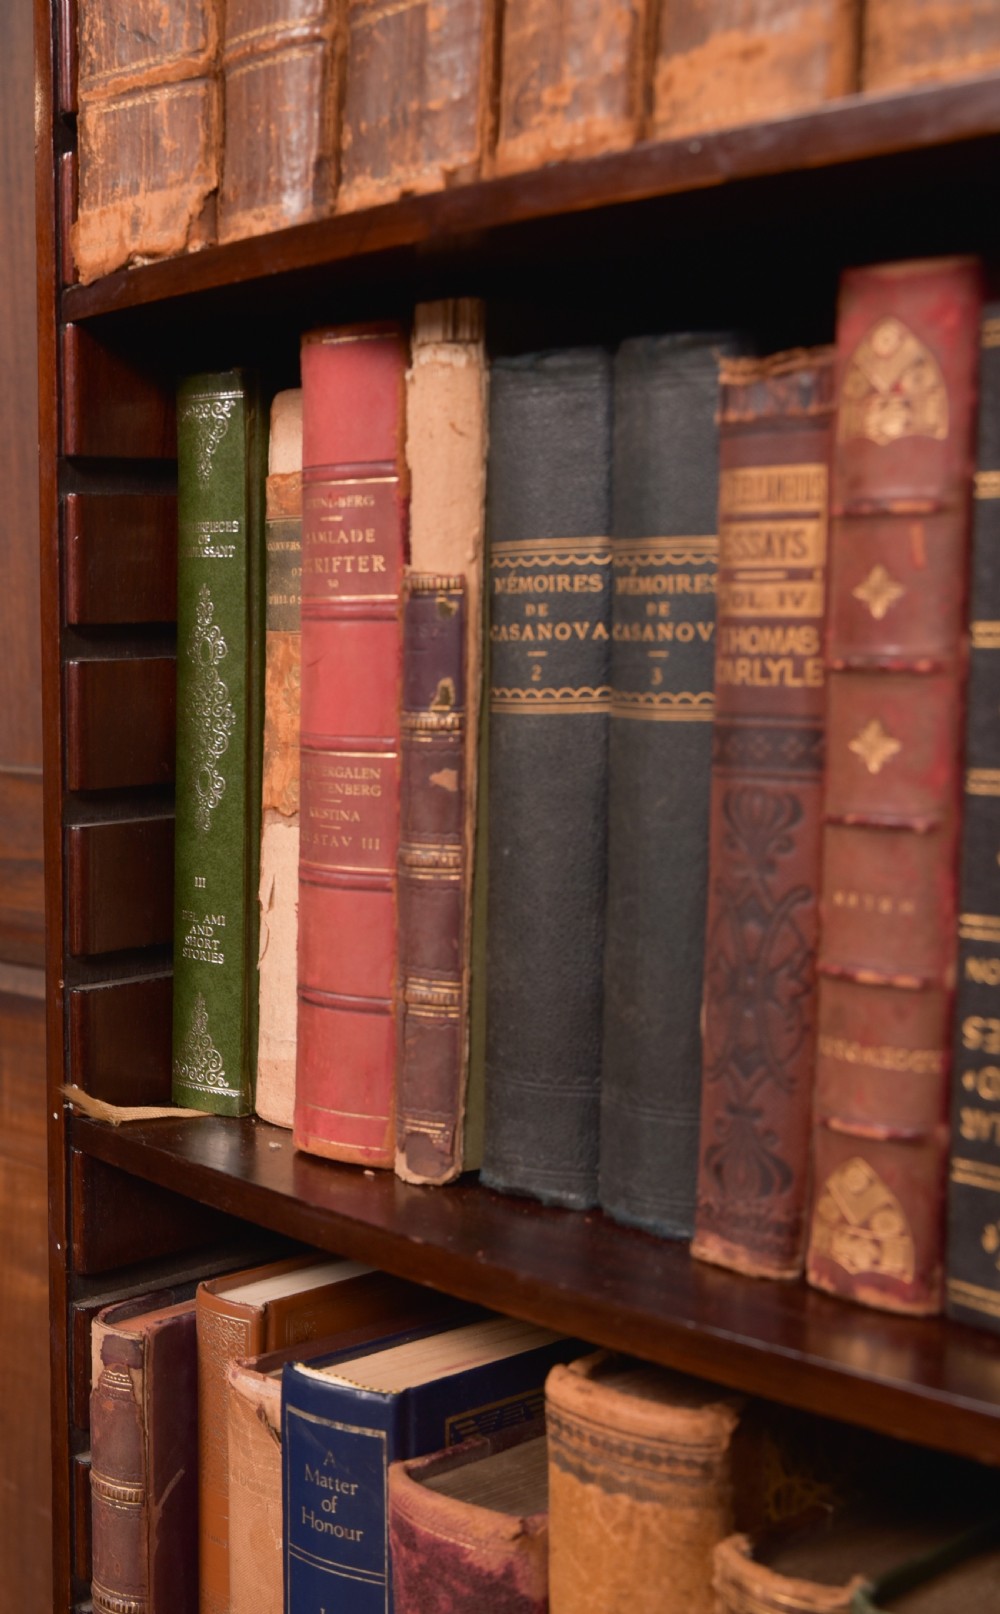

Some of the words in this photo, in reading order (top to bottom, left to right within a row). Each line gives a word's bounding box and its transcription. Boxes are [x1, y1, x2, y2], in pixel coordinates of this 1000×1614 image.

[197, 534, 211, 545] OF
[494, 570, 604, 595] MÉMOIRES
[525, 603, 549, 617] DE
[646, 601, 671, 617] DE
[490, 622, 610, 642] CASANOVA
[613, 622, 715, 642] CASANOV
[531, 664, 542, 682] 2
[652, 667, 664, 686] 3
[361, 836, 381, 851] III
[194, 876, 206, 888] III
[202, 913, 226, 927] AMI
[189, 924, 214, 937] AND
[184, 935, 221, 951] SHORT
[182, 948, 225, 965] STORIES
[323, 1450, 337, 1467] A
[304, 1463, 359, 1496] Matter
[321, 1495, 338, 1514] of
[301, 1506, 364, 1543] Honour
